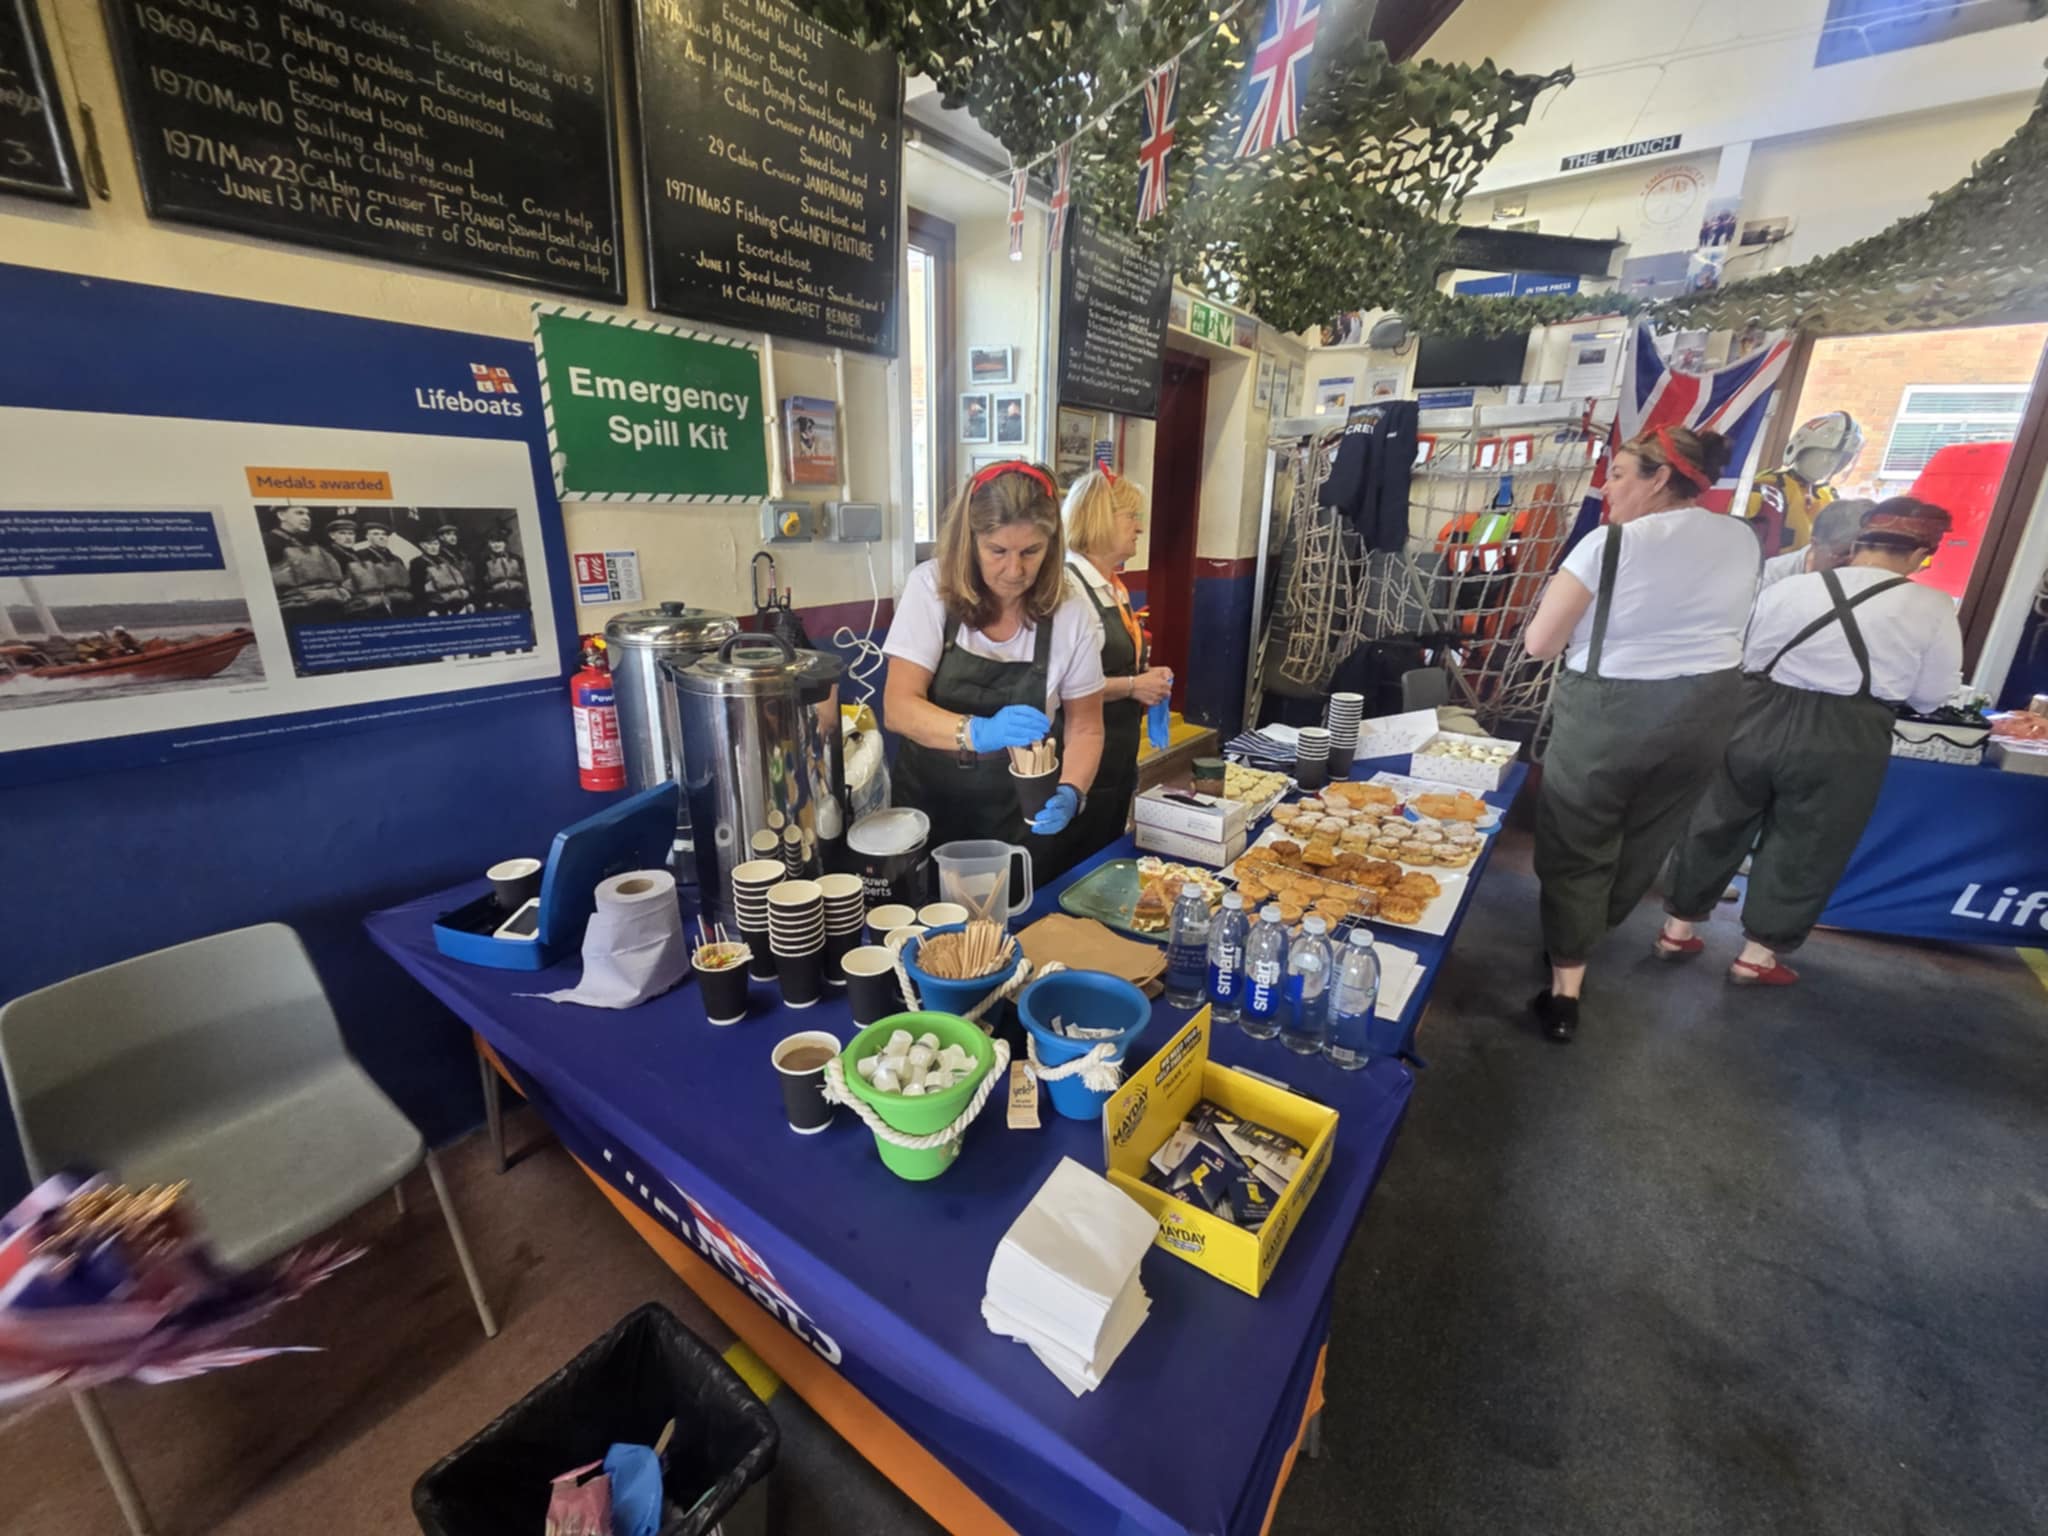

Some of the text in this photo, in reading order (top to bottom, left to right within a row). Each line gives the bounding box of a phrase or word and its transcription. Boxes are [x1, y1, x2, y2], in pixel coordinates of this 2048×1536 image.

[243, 5, 260, 30] 3
[287, 0, 346, 29] ishing
[432, 39, 503, 83] Escorted
[722, 2, 769, 43] Escorted
[793, 18, 824, 49] LISLE
[135, 3, 198, 45] 1969
[279, 14, 350, 66] Fishing
[435, 69, 507, 114] Escorted
[464, 30, 595, 95] Saved boat and 3
[726, 29, 765, 64] Motor
[798, 68, 829, 97] Carol
[281, 52, 505, 139] Coble MARY ROBINSON
[289, 79, 374, 122] Escorted
[151, 65, 474, 179] 1970 MAY 10 Sailing dinghy and
[724, 86, 852, 160] Cabin Cruiser AARON
[798, 94, 827, 122] Saved
[880, 131, 888, 150] 2
[708, 135, 725, 158] 29
[727, 144, 759, 171] Cabin
[762, 157, 802, 186] Cruiser
[800, 145, 829, 173] Saved
[880, 179, 887, 196] 5
[1567, 135, 1676, 170] THE LAUNCH
[162, 127, 216, 166] 1971
[217, 141, 268, 176] MAY
[268, 154, 300, 184] 23
[300, 163, 360, 200] Cabin
[367, 189, 426, 214] cruiser
[506, 213, 546, 241] Saved
[548, 223, 575, 250] boat
[577, 235, 600, 254] and
[602, 239, 613, 257] 6
[297, 136, 352, 168] Yacht
[359, 155, 405, 181] Club
[410, 174, 464, 195] rescue
[521, 197, 560, 222] Gave
[564, 209, 593, 236] help
[800, 196, 830, 222] Saved
[217, 173, 610, 284] JUNE 13 MFV GANNET of Shoreham Gave help
[665, 177, 875, 262] 1977 MAR 5 Fishing Coble NEW VENTURE
[696, 251, 723, 274] JUNE
[725, 260, 731, 275] 1
[738, 261, 771, 285] Speed
[773, 273, 794, 290] boat
[796, 277, 826, 298] SALLY
[736, 233, 788, 267] Escorted
[722, 283, 863, 329] 14 Coble MARGARET RENNER
[1535, 285, 1549, 294] THE
[1549, 281, 1573, 292] PRESS
[415, 388, 523, 417] Lifeboats
[568, 366, 749, 420] Emergency
[608, 415, 728, 451] Spill Kit
[256, 475, 384, 491] Medals awarded
[1217, 942, 1235, 995] smart
[1253, 960, 1274, 1012] smart
[1112, 1086, 1149, 1147] MAYDAY
